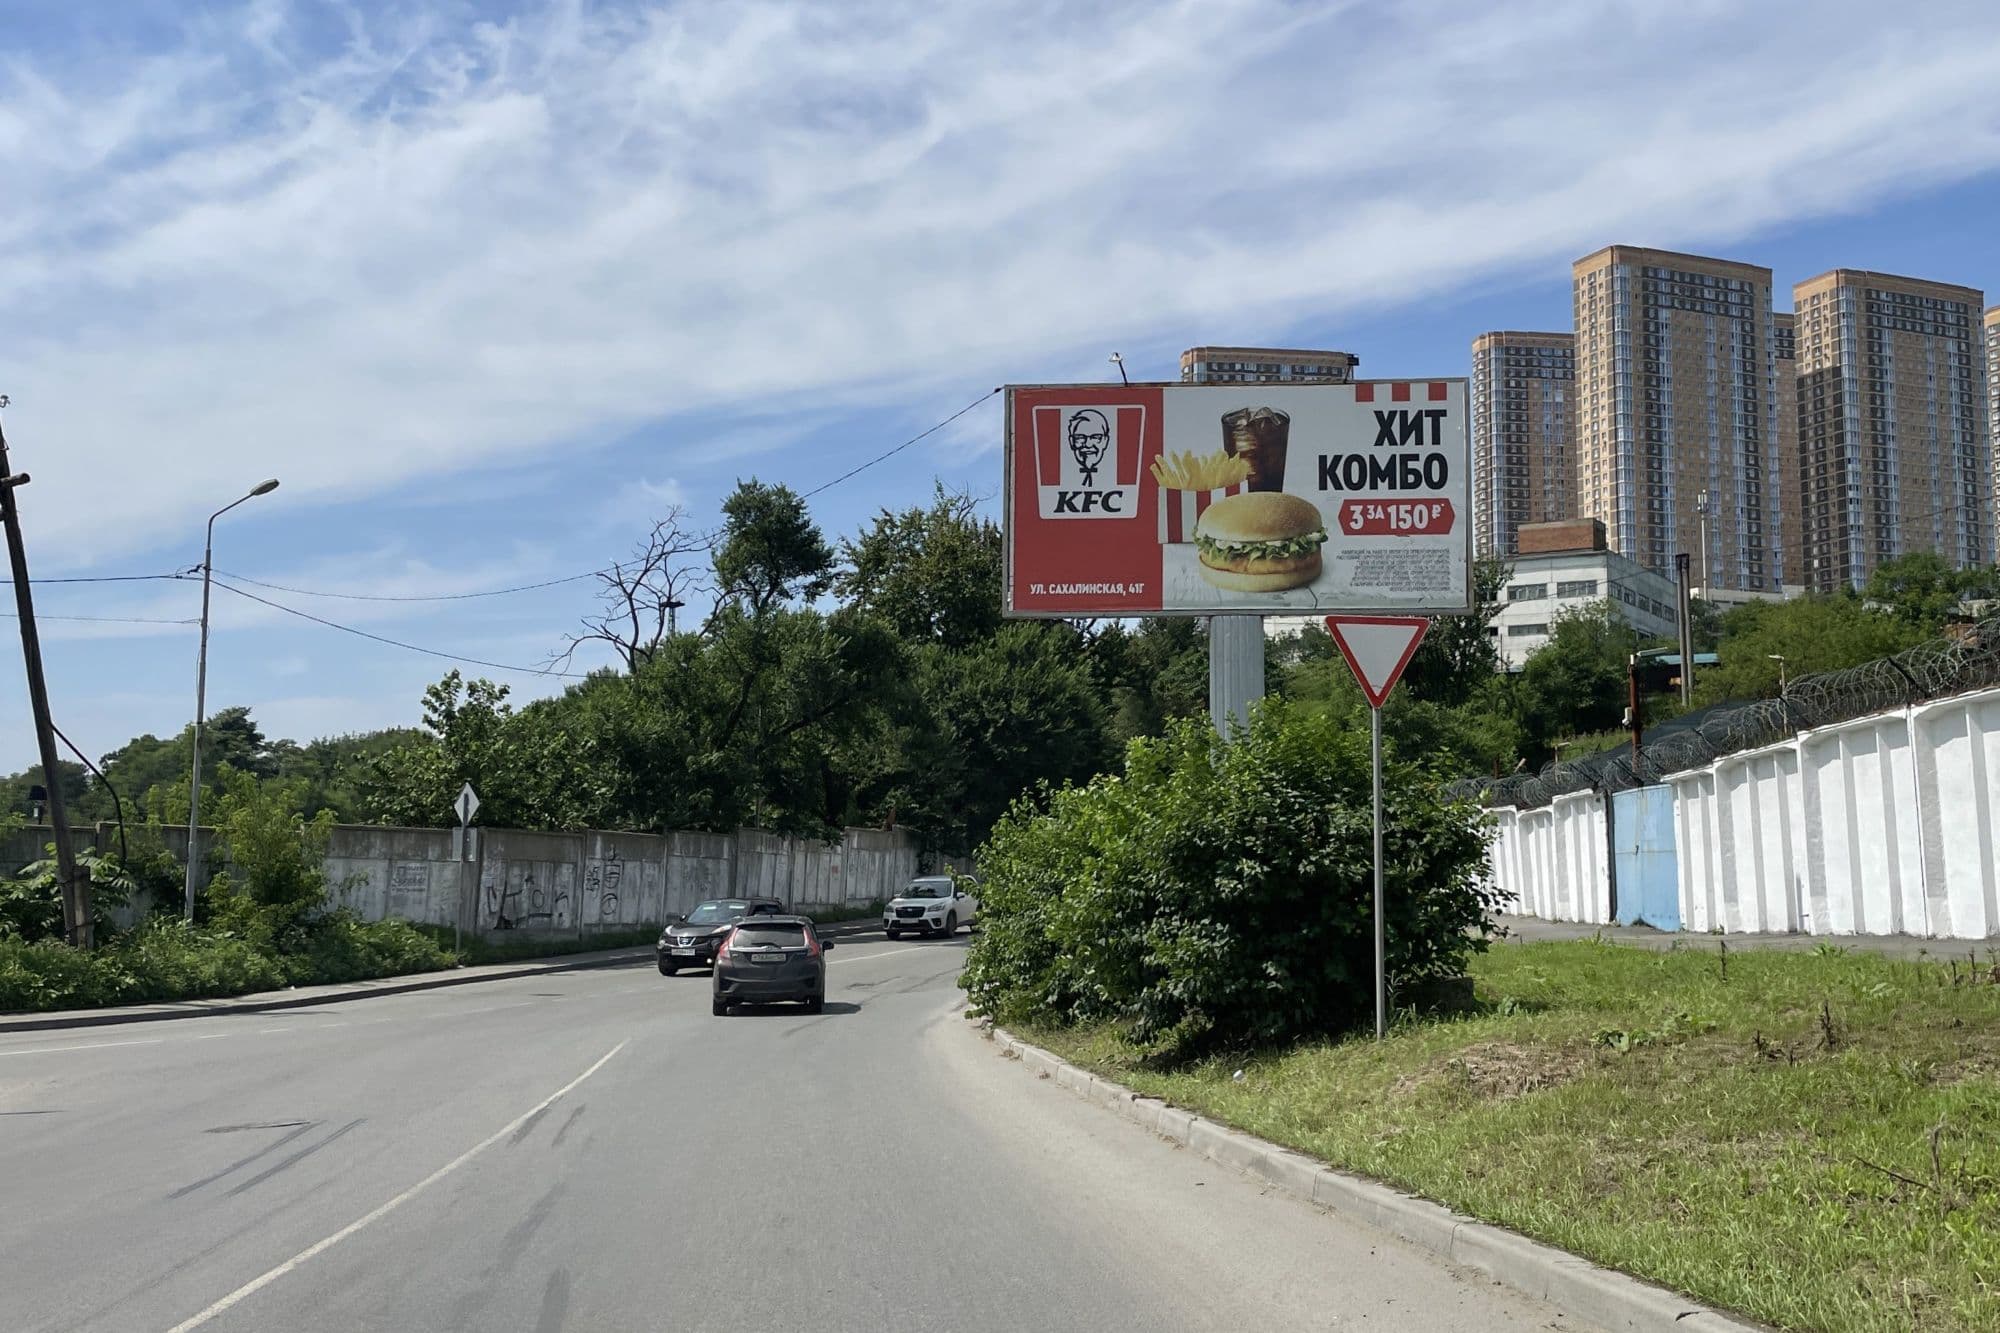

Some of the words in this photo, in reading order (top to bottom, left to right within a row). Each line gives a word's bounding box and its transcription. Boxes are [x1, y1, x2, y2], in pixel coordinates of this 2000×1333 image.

[1373, 409, 1448, 447] ХИТ
[1318, 452, 1449, 491] КОМБО
[1053, 490, 1124, 513] KFC
[1350, 504, 1364, 530] 3
[1030, 583, 1047, 595] УЛ.
[1049, 583, 1127, 596] САХАЛИНСКАЯ,
[1128, 583, 1145, 594] 41Г
